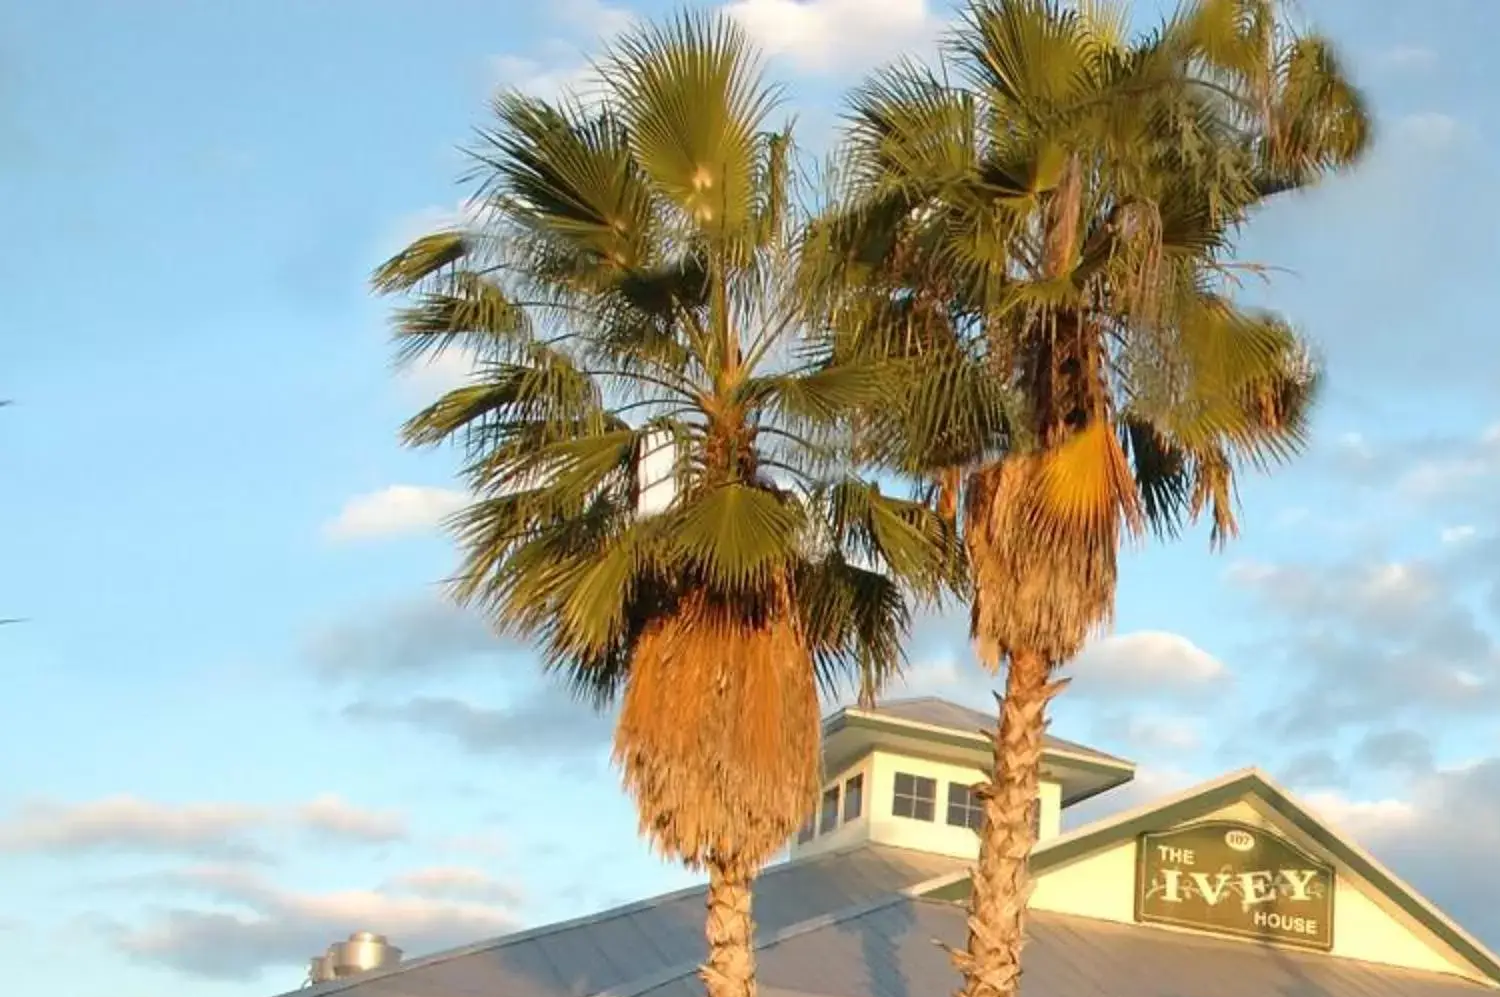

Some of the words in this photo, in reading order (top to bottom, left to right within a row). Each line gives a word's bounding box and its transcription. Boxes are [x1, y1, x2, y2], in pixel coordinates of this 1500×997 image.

[1157, 845, 1194, 865] THE
[1160, 868, 1317, 906] IVEY
[1254, 911, 1318, 935] HOUSE
